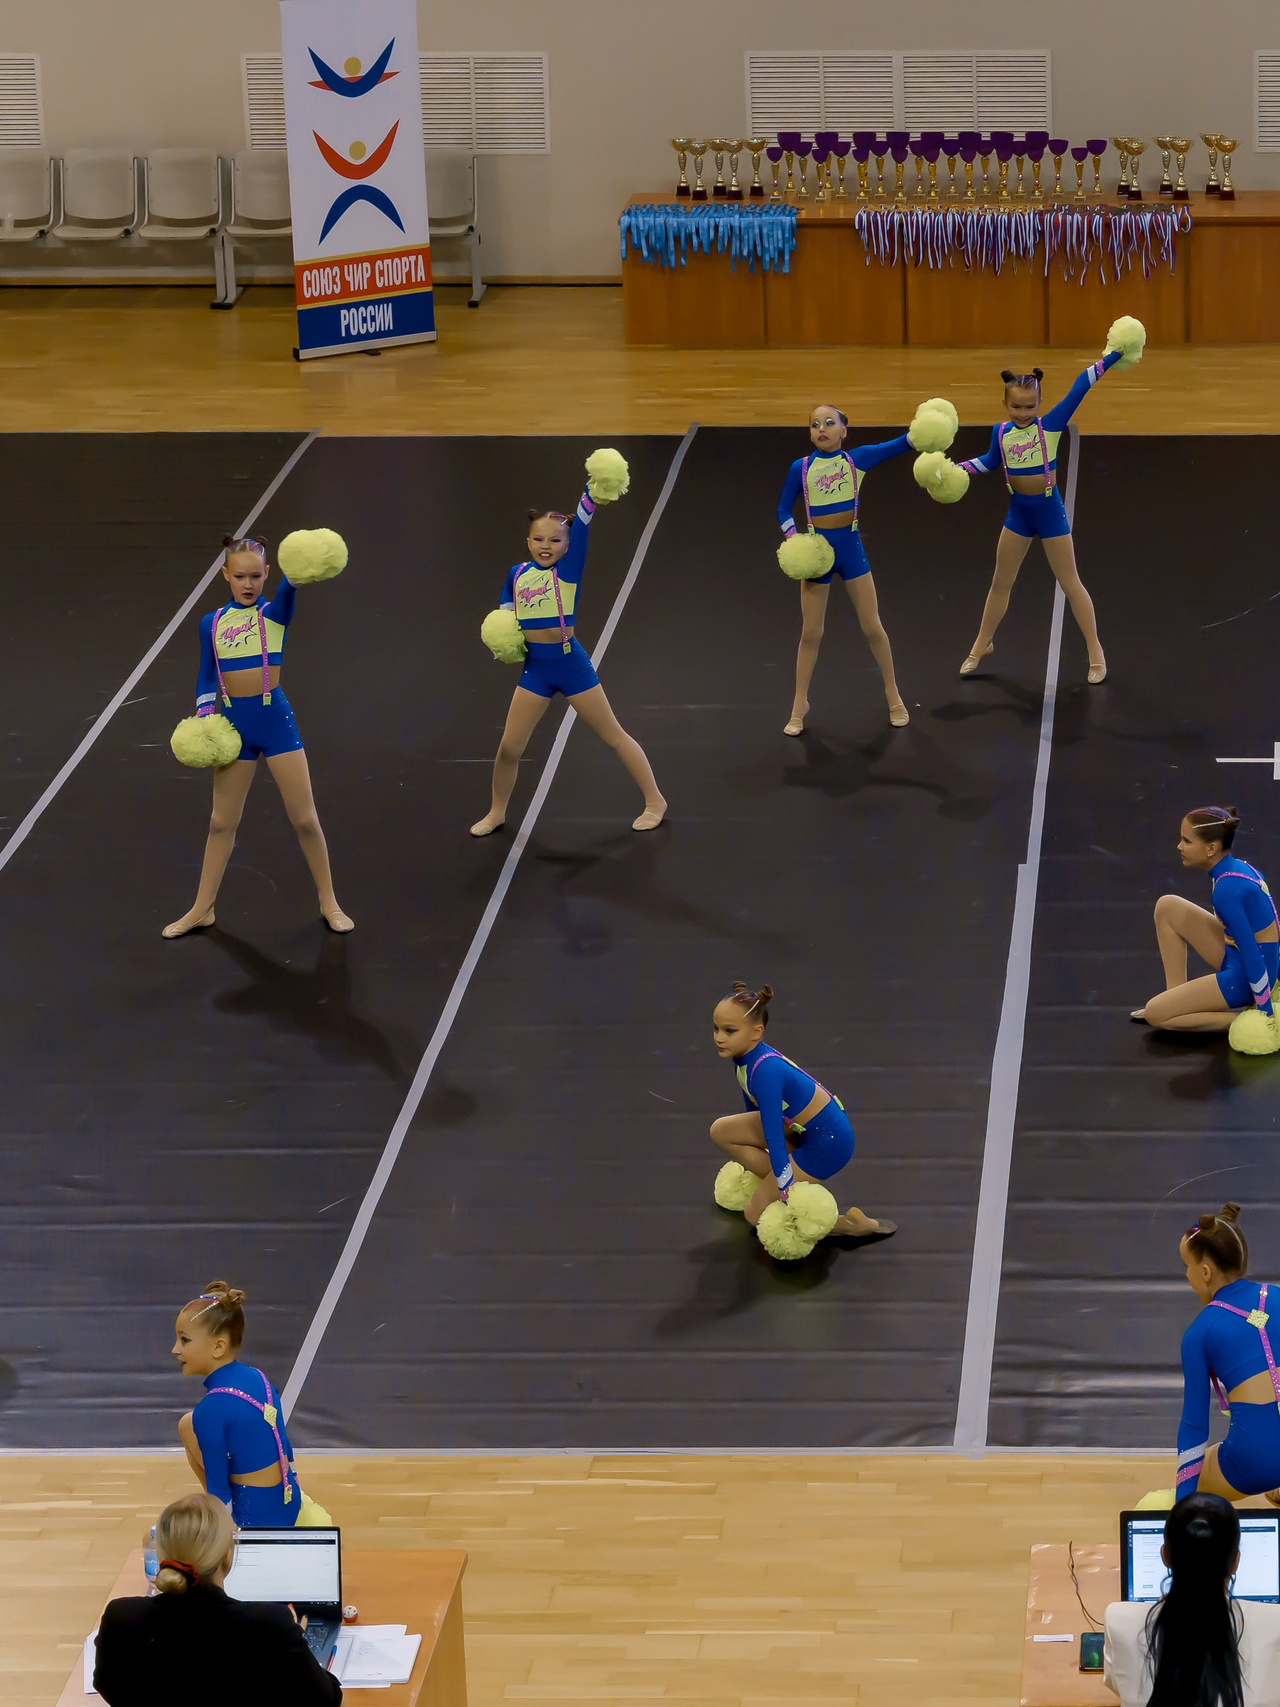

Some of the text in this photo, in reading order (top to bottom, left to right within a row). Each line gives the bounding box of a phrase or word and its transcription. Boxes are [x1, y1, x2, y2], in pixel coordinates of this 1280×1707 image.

[303, 254, 427, 299] СОЮЗ ЧИР СПОРТА
[340, 302, 394, 337] РОССИИ
